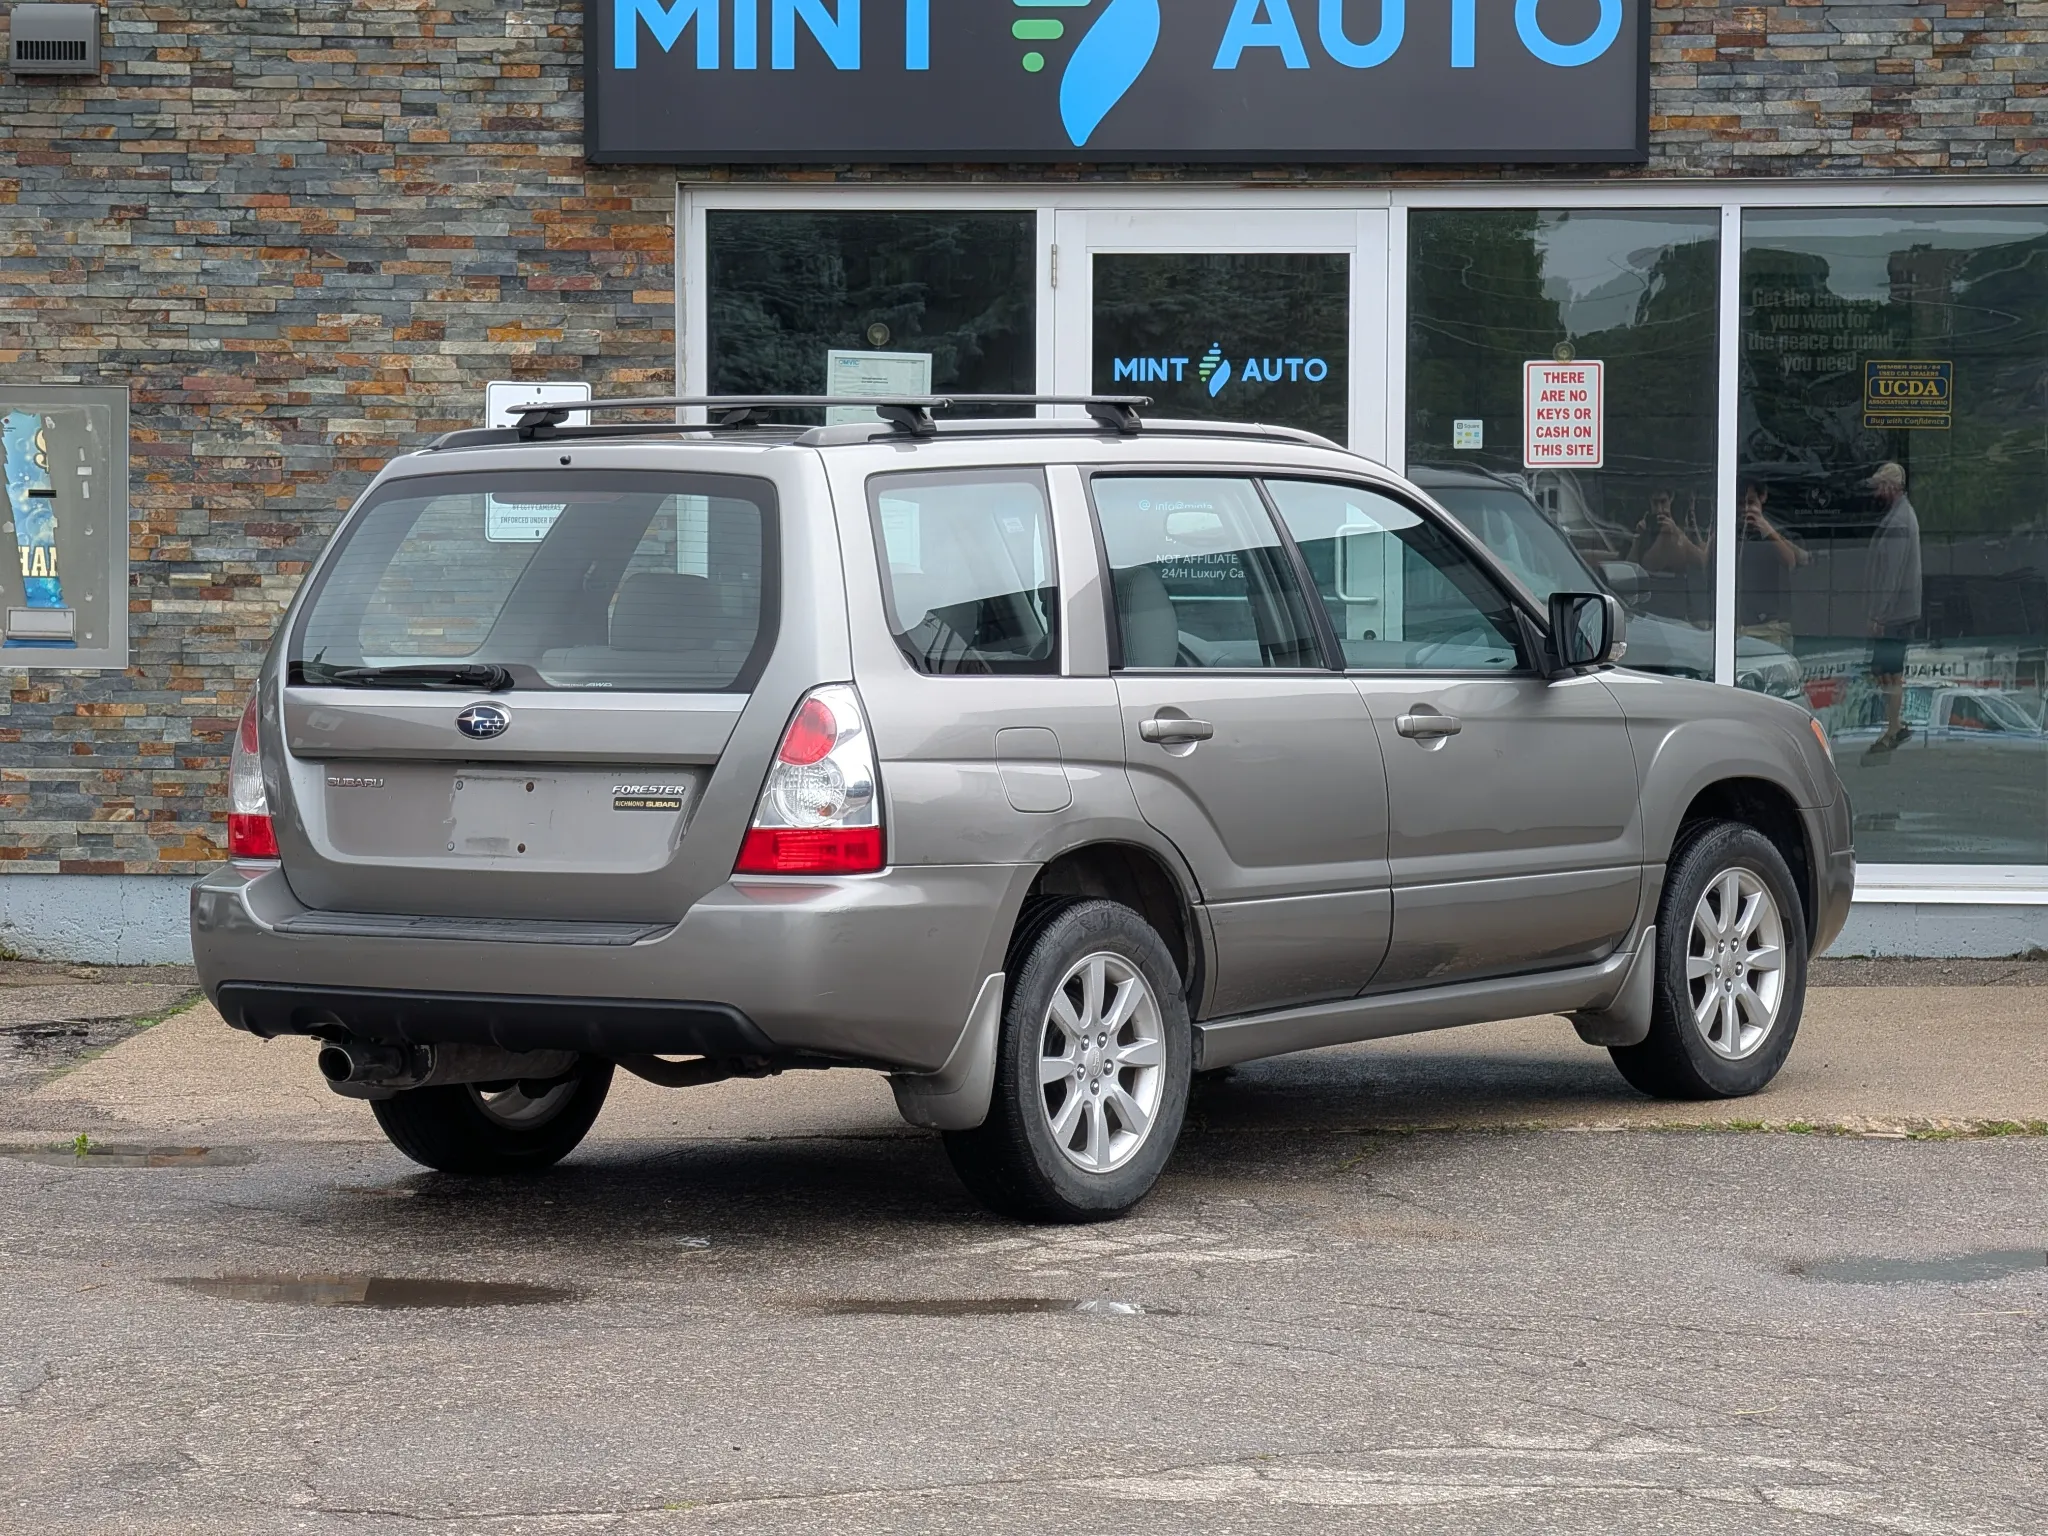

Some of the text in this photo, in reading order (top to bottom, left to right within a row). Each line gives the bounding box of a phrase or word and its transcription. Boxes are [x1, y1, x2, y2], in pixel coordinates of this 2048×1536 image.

[1752, 288, 1780, 307] Get
[1783, 288, 1810, 307] the
[1770, 308, 1871, 333] you want for
[1747, 330, 1893, 353] the peace of mind
[1114, 358, 1328, 381] MINT AUTO
[1783, 352, 1857, 377] you need
[1543, 372, 1585, 383] THERE
[1879, 380, 1940, 396] UCDA
[1540, 390, 1587, 401] ARE NO
[1537, 408, 1591, 420] KEYS OR
[1536, 426, 1591, 438] CASH ON
[1533, 444, 1594, 456] THIS SITE
[1156, 553, 1180, 564] NOT
[1161, 568, 1245, 580] 24/H Luxury Ca
[327, 777, 384, 788] SUBARU
[612, 785, 685, 795] FORESTER
